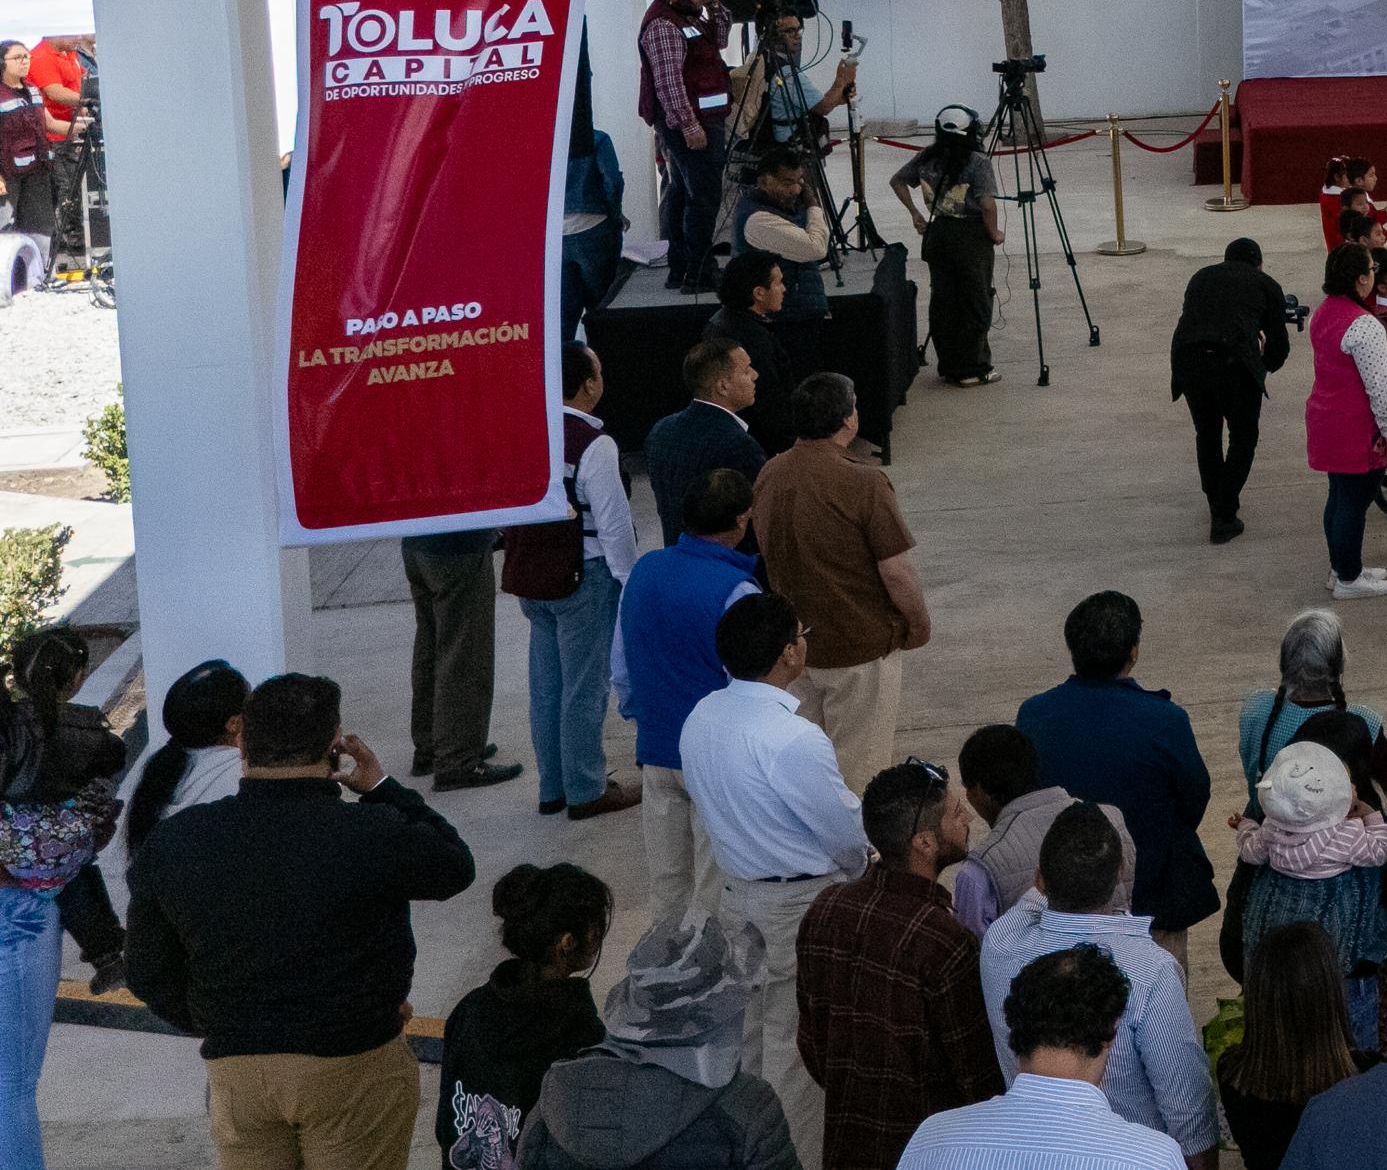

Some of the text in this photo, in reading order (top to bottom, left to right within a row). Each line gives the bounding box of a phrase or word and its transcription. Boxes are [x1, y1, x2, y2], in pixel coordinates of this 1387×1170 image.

[325, 87, 340, 102] DE
[341, 82, 464, 100] OPORTUNIDADES
[469, 68, 540, 87] PROGRESO
[346, 301, 482, 336] PASO A PASO
[298, 321, 529, 368] LA TRANSFORMACIÓN
[367, 359, 455, 386] AVANZA
